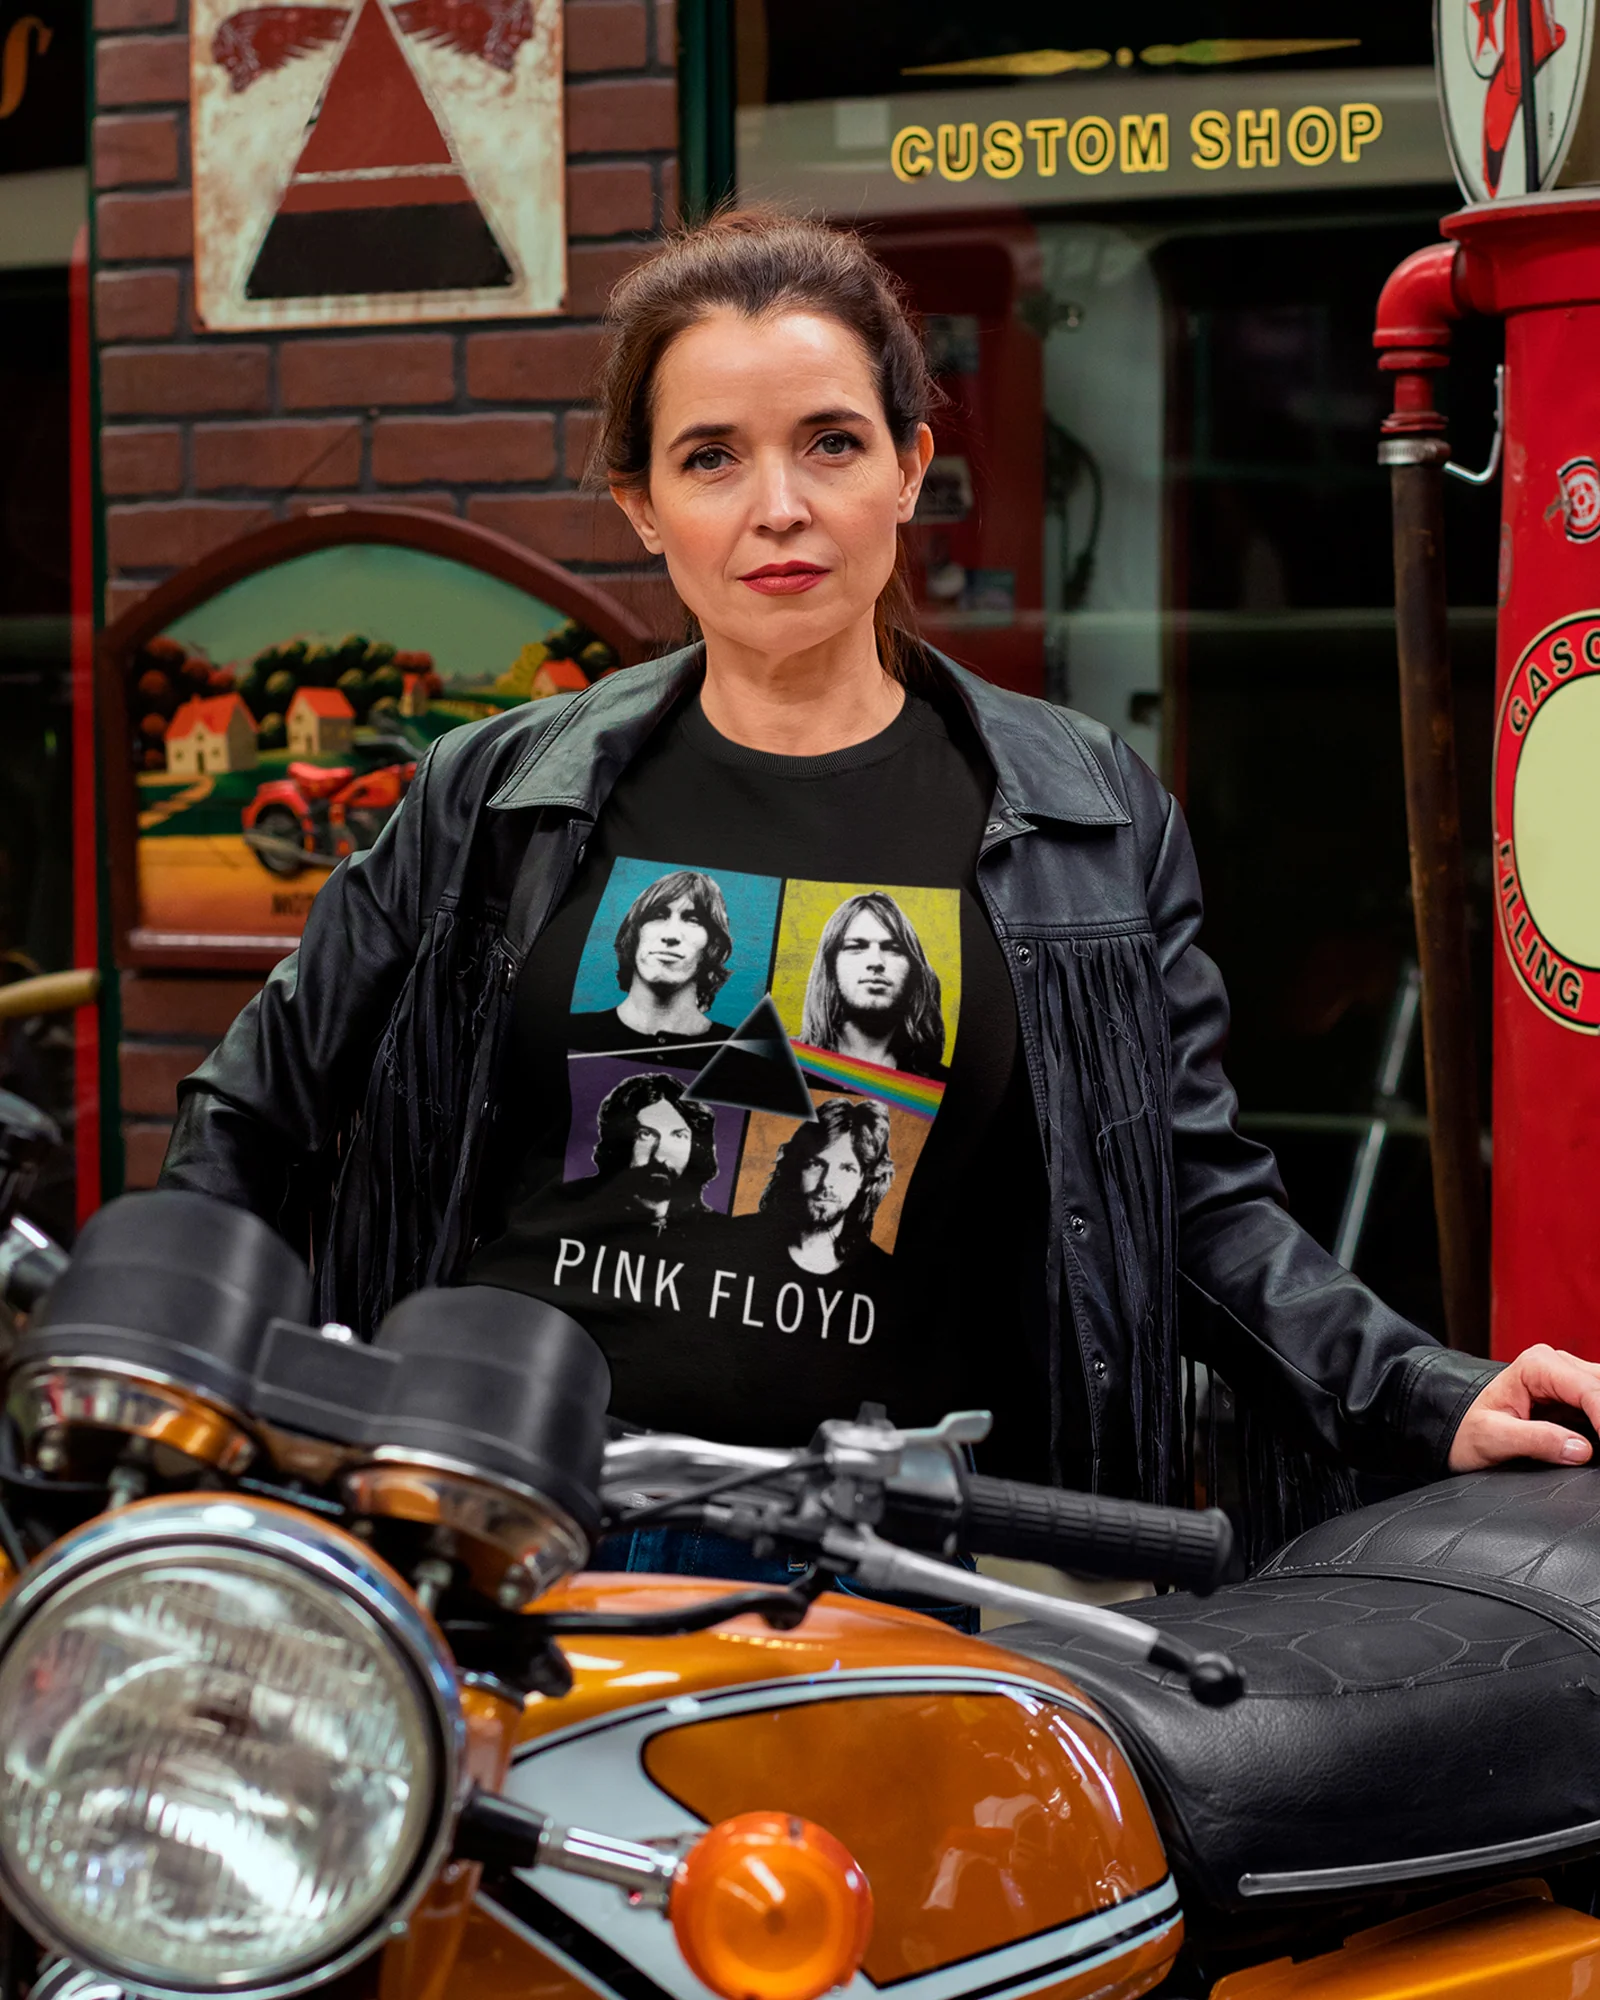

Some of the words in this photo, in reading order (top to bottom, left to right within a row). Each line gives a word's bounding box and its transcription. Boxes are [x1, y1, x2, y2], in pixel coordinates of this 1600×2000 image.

[891, 113, 1168, 184] CUSTOM
[1190, 103, 1383, 170] SHOP
[554, 1238, 684, 1312] PINK
[709, 1269, 875, 1345] FLOYD
